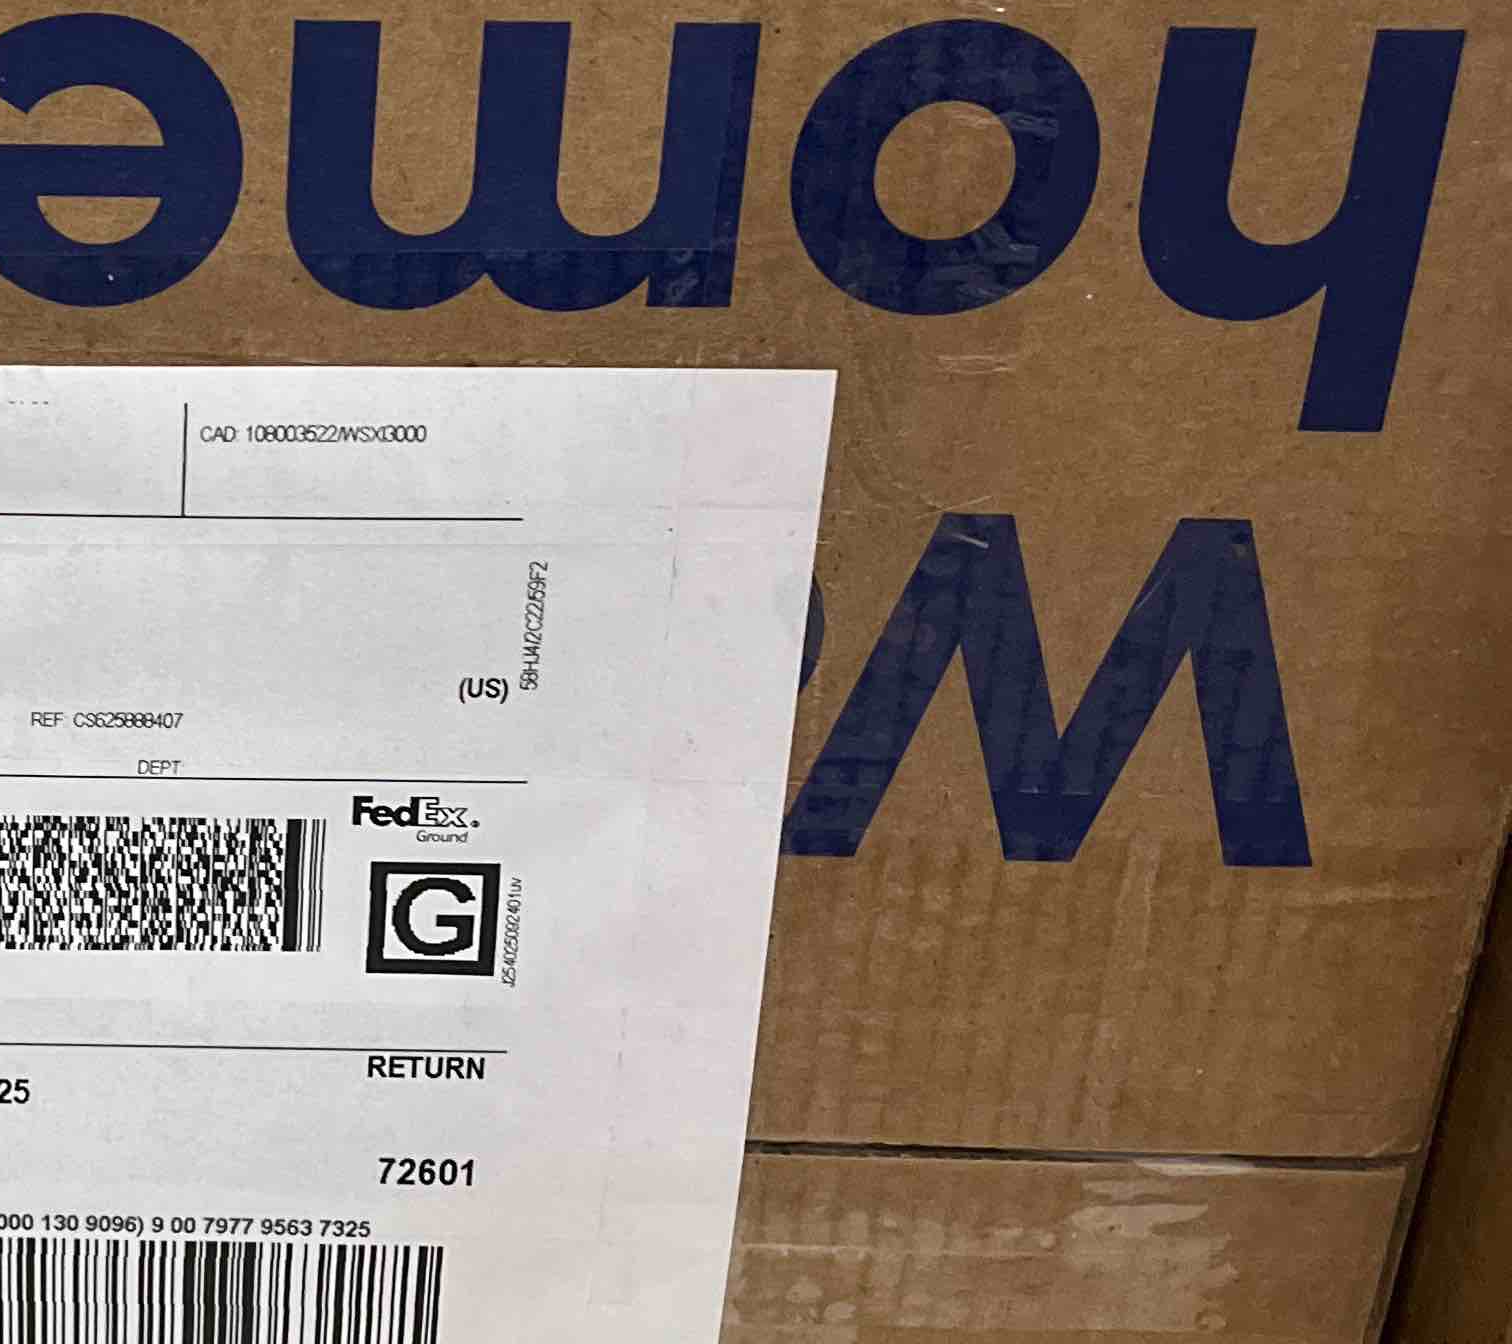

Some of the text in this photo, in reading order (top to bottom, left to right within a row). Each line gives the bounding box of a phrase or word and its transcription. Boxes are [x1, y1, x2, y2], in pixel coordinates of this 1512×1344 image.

[459, 678, 509, 704] (US)
[416, 830, 469, 844] Ground
[392, 877, 476, 956] G
[367, 1055, 485, 1079] RETURN
[378, 1157, 475, 1187] 72601
[42, 1214, 79, 1232] 130
[85, 1215, 144, 1237] 9096)
[151, 1216, 164, 1234] 9
[170, 1216, 196, 1234] 00
[203, 1216, 254, 1235] 7977
[261, 1217, 313, 1237] 9563
[320, 1218, 371, 1238] 7325
